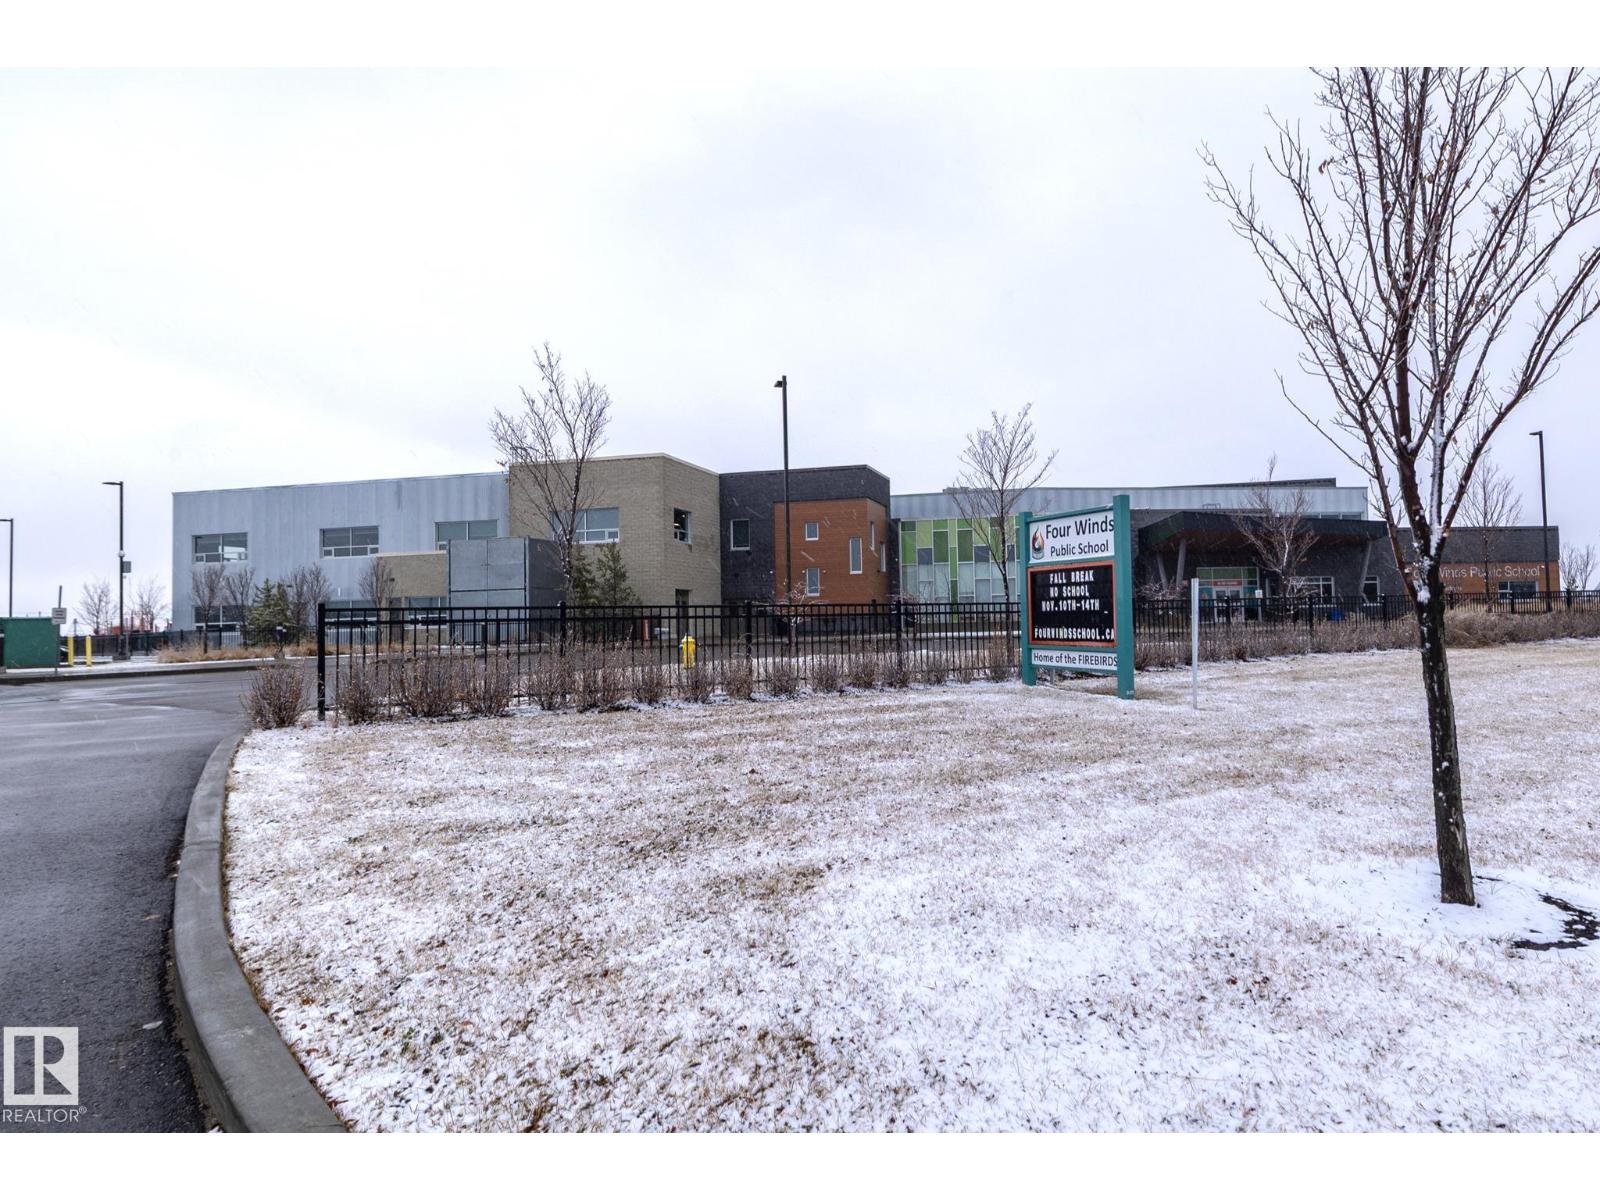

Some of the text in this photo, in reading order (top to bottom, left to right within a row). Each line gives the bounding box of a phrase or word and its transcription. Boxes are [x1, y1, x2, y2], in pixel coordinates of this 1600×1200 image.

[1046, 515, 1114, 539] Four Winds
[1051, 539, 1108, 557] Public School
[1049, 570, 1094, 584] FALL BREAK
[1504, 565, 1540, 577] School
[1050, 585, 1089, 598] NO SCHOOL
[1033, 652, 1118, 667] Home of the FIREBIRDS
